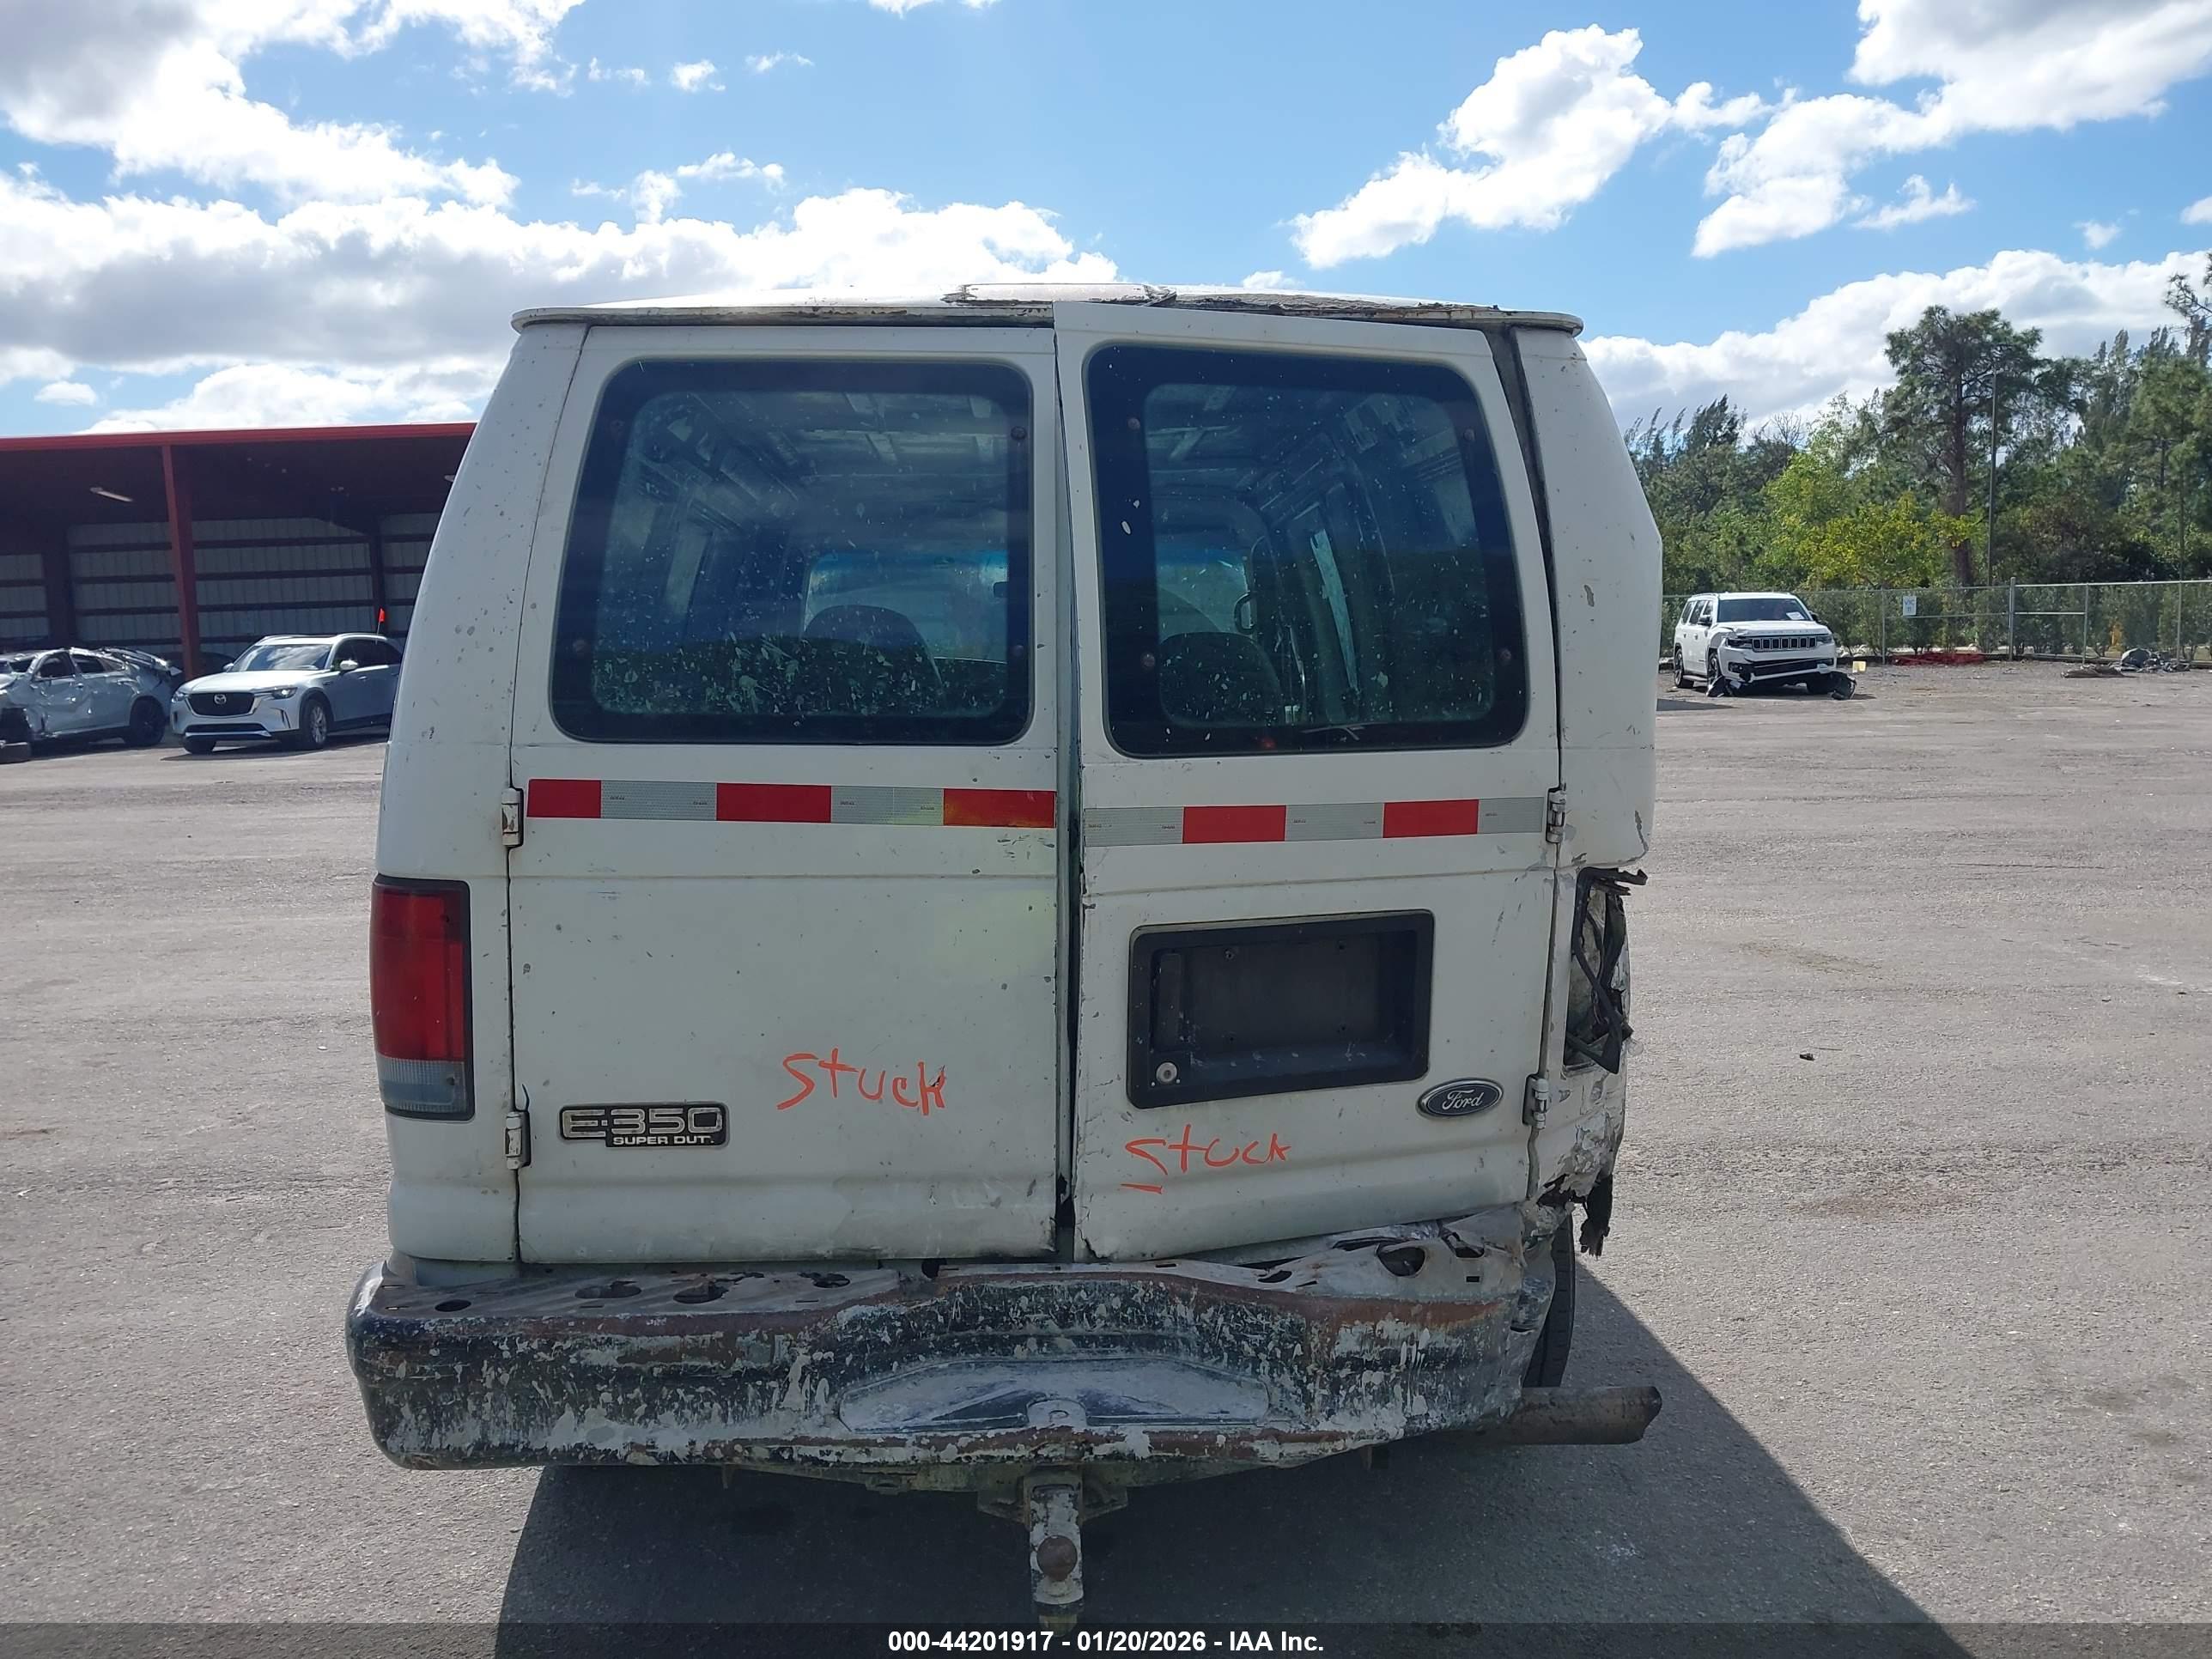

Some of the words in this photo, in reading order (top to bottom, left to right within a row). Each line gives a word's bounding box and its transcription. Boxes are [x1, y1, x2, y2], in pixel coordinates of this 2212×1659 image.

[1442, 1089, 1485, 1110] Ford
[612, 1135, 669, 1146] SUPER
[673, 1134, 715, 1145] DUT
